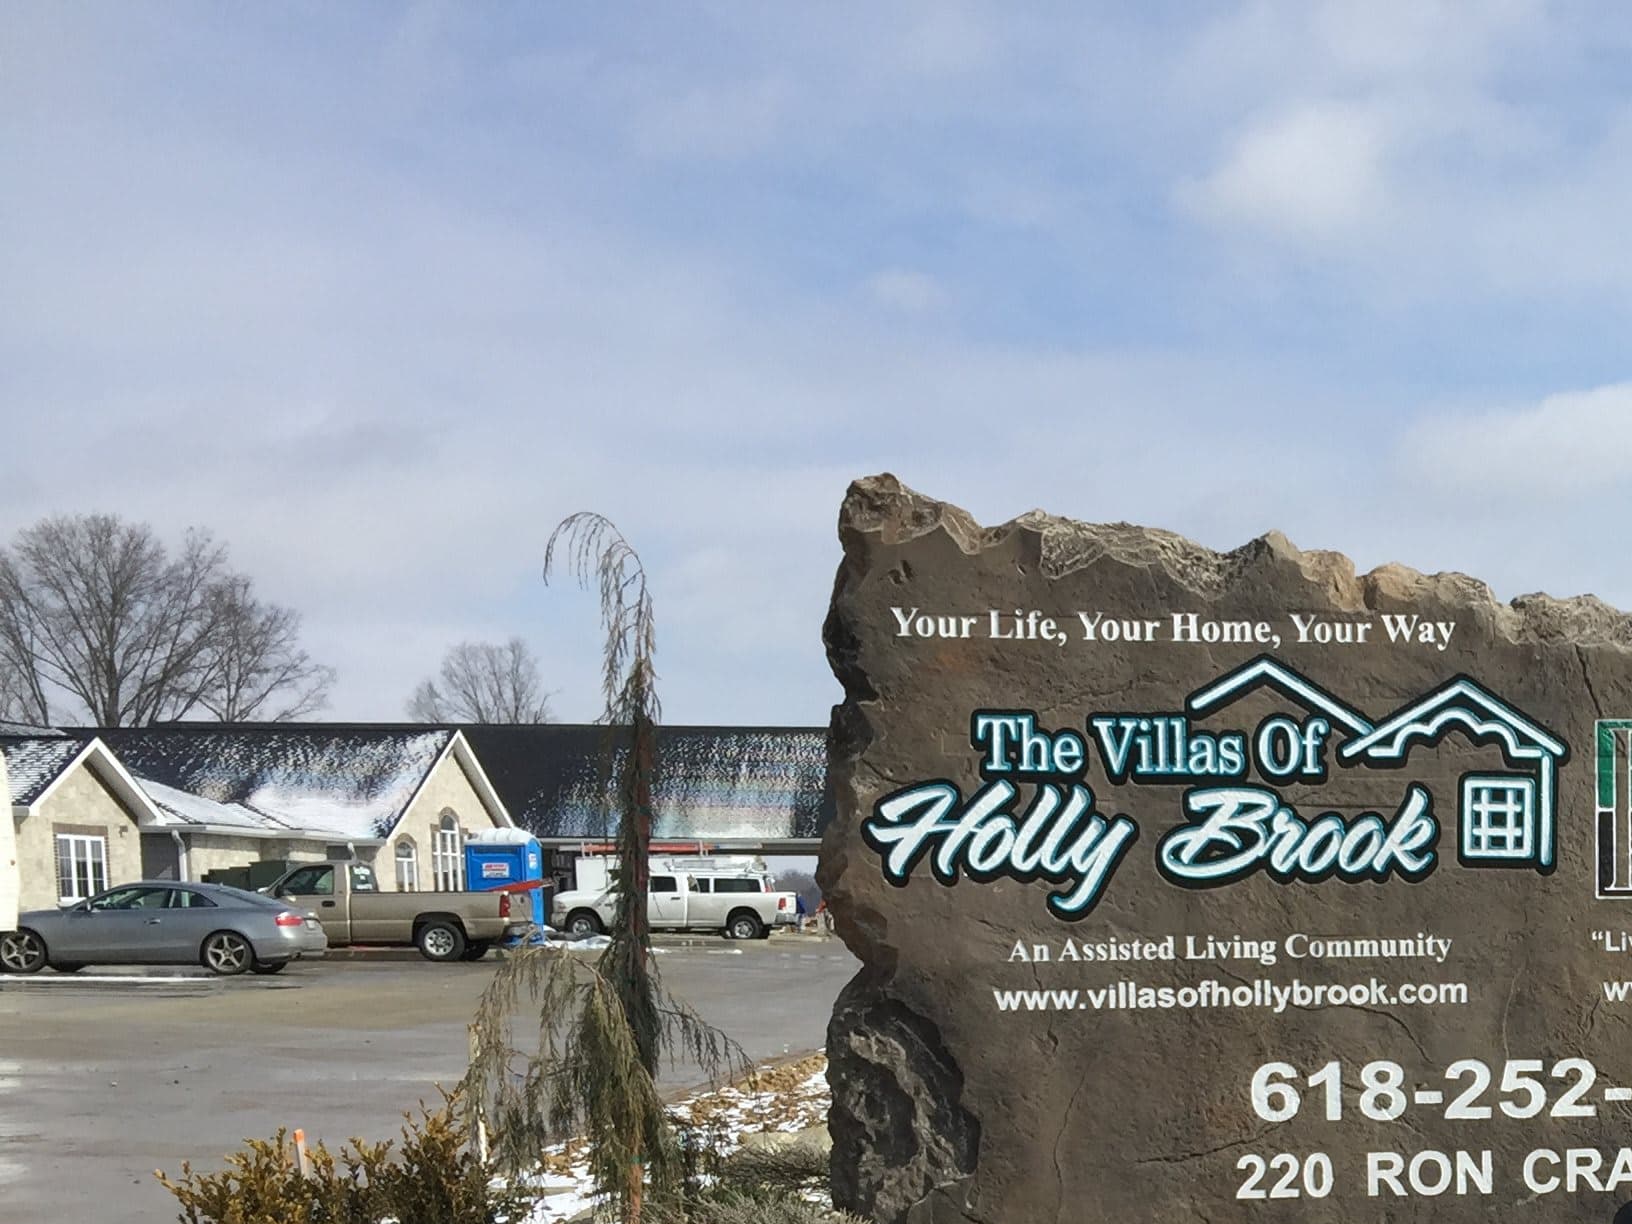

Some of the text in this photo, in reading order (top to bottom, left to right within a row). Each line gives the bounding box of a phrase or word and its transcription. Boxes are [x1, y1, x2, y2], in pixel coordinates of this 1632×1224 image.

[890, 607, 1456, 651] Your Life, Your Home, Your Way
[975, 715, 1330, 775] The Villas Of
[868, 779, 1436, 912] Holly Brook
[1007, 932, 1453, 965] An Assisted Living Community
[993, 978, 1468, 1013] www.villasofhollybrook.com
[1235, 1151, 1335, 1199] 220
[1367, 1149, 1493, 1197] RON
